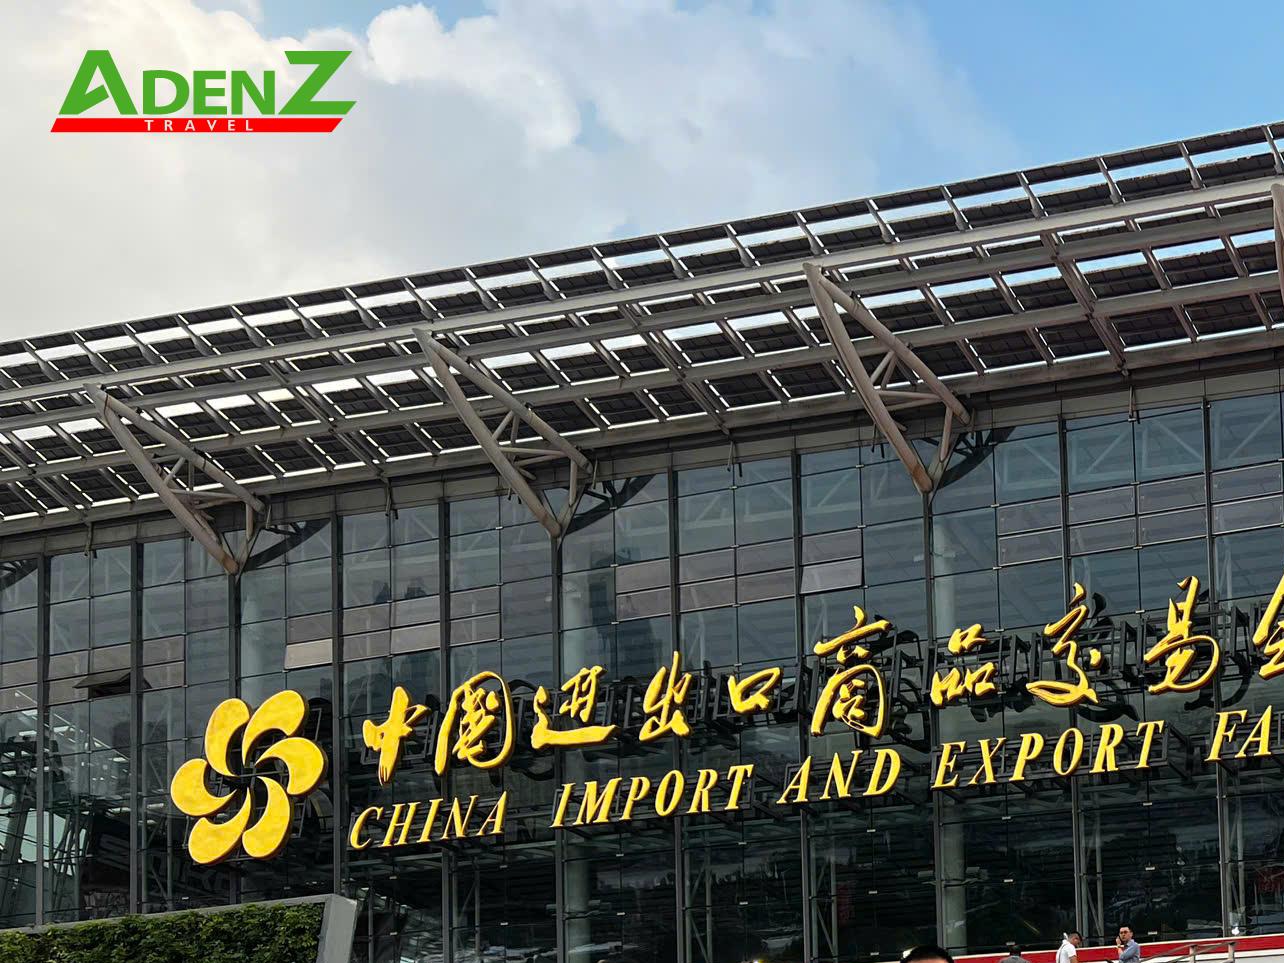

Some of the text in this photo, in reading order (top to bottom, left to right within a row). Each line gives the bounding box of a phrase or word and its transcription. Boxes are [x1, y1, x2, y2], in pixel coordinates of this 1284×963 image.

[349, 790, 509, 850] CHINA
[551, 763, 755, 829] IMPORT
[776, 748, 901, 804] AND
[931, 720, 1167, 790] EXPORT
